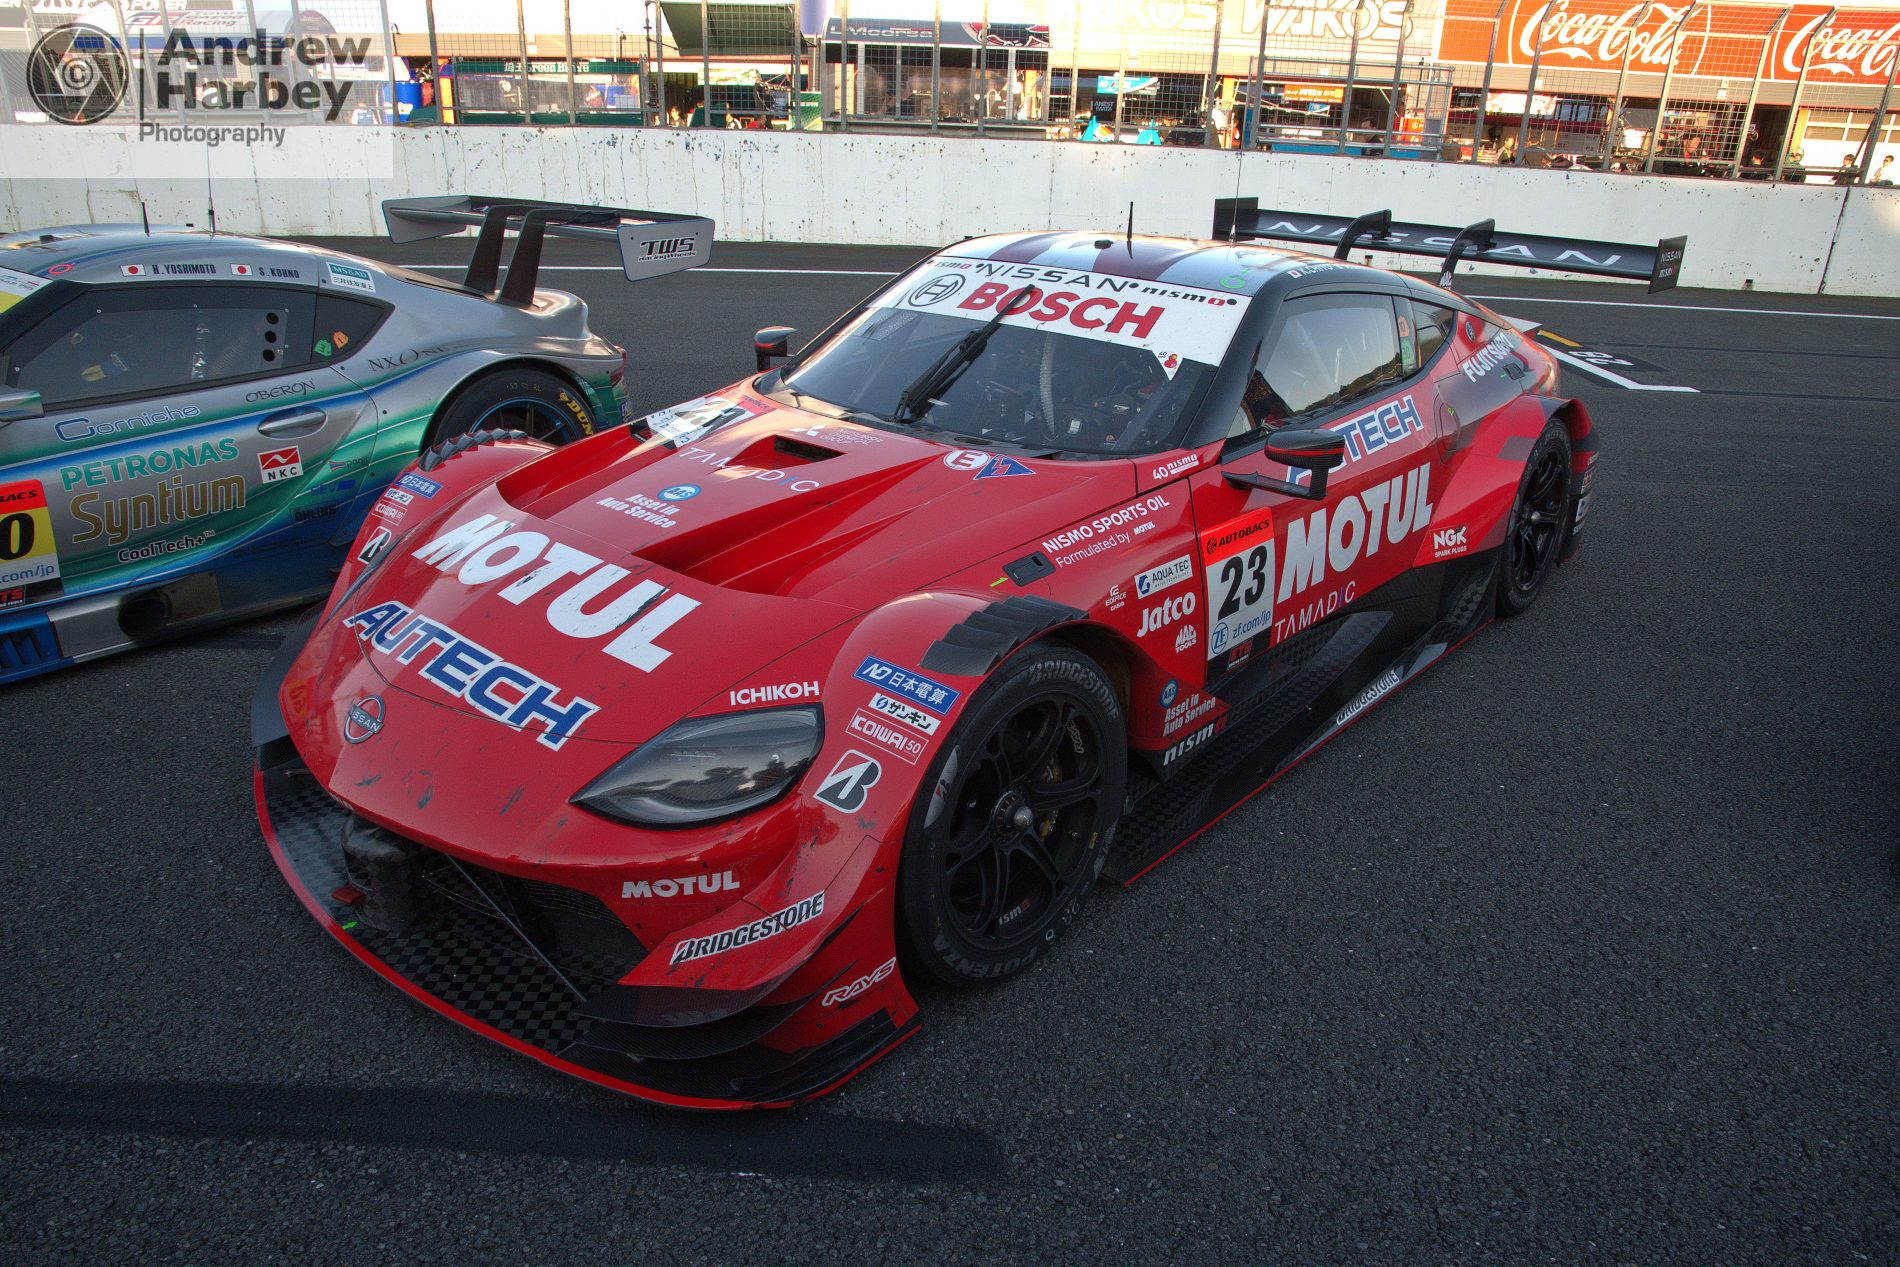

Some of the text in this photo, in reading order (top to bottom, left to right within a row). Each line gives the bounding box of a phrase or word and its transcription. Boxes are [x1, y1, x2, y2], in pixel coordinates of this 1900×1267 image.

[1519, 2, 1698, 64] Coca-Cola
[641, 237, 696, 255] TWS
[333, 266, 367, 278] MS&AD
[976, 263, 1130, 293] NISSAN
[1134, 286, 1227, 306] nismo
[958, 281, 1166, 339] BOSCH
[245, 380, 316, 403] OBERON
[54, 405, 201, 443] Corniche
[59, 437, 241, 492] PETRONAS
[1152, 466, 1169, 479] 40
[1166, 453, 1198, 470] nismo
[70, 474, 247, 546] Syntium
[596, 496, 677, 528] Auto Service
[625, 493, 681, 516] Asset in
[1041, 494, 1170, 554] NISMO SPORTS OIL
[1218, 518, 1270, 548] AUTOBACS
[1276, 462, 1434, 605] MOTUL
[1433, 526, 1467, 550] NGK
[1055, 521, 1156, 568] Formulated by MOTUL
[1151, 558, 1190, 583] AQUA TEC
[1217, 545, 1268, 621] 23
[411, 513, 702, 674] MOTUL
[1105, 591, 1127, 607] EDIFICE
[1110, 601, 1125, 612] CASIO
[1274, 581, 1356, 643] TAMADIC
[1136, 591, 1196, 638] Jatco
[1232, 609, 1271, 640] zf.com/jp
[1176, 624, 1197, 647] MAC
[1176, 638, 1197, 653] TOOLS
[342, 600, 602, 752] AUTECH
[730, 680, 820, 706] ICHIKOH
[888, 672, 949, 705] 日本電算
[1029, 659, 1120, 721] BRIDGESTONE
[887, 701, 933, 730] サンキン
[1162, 697, 1216, 737] Auto Service
[1165, 693, 1200, 723] Asset in
[851, 715, 922, 755] KOIWAI 50
[1163, 715, 1227, 766] nismo
[621, 870, 740, 899] MOTUL
[669, 890, 825, 966] BRIDGESTONE
[821, 956, 897, 1007] RAYS
